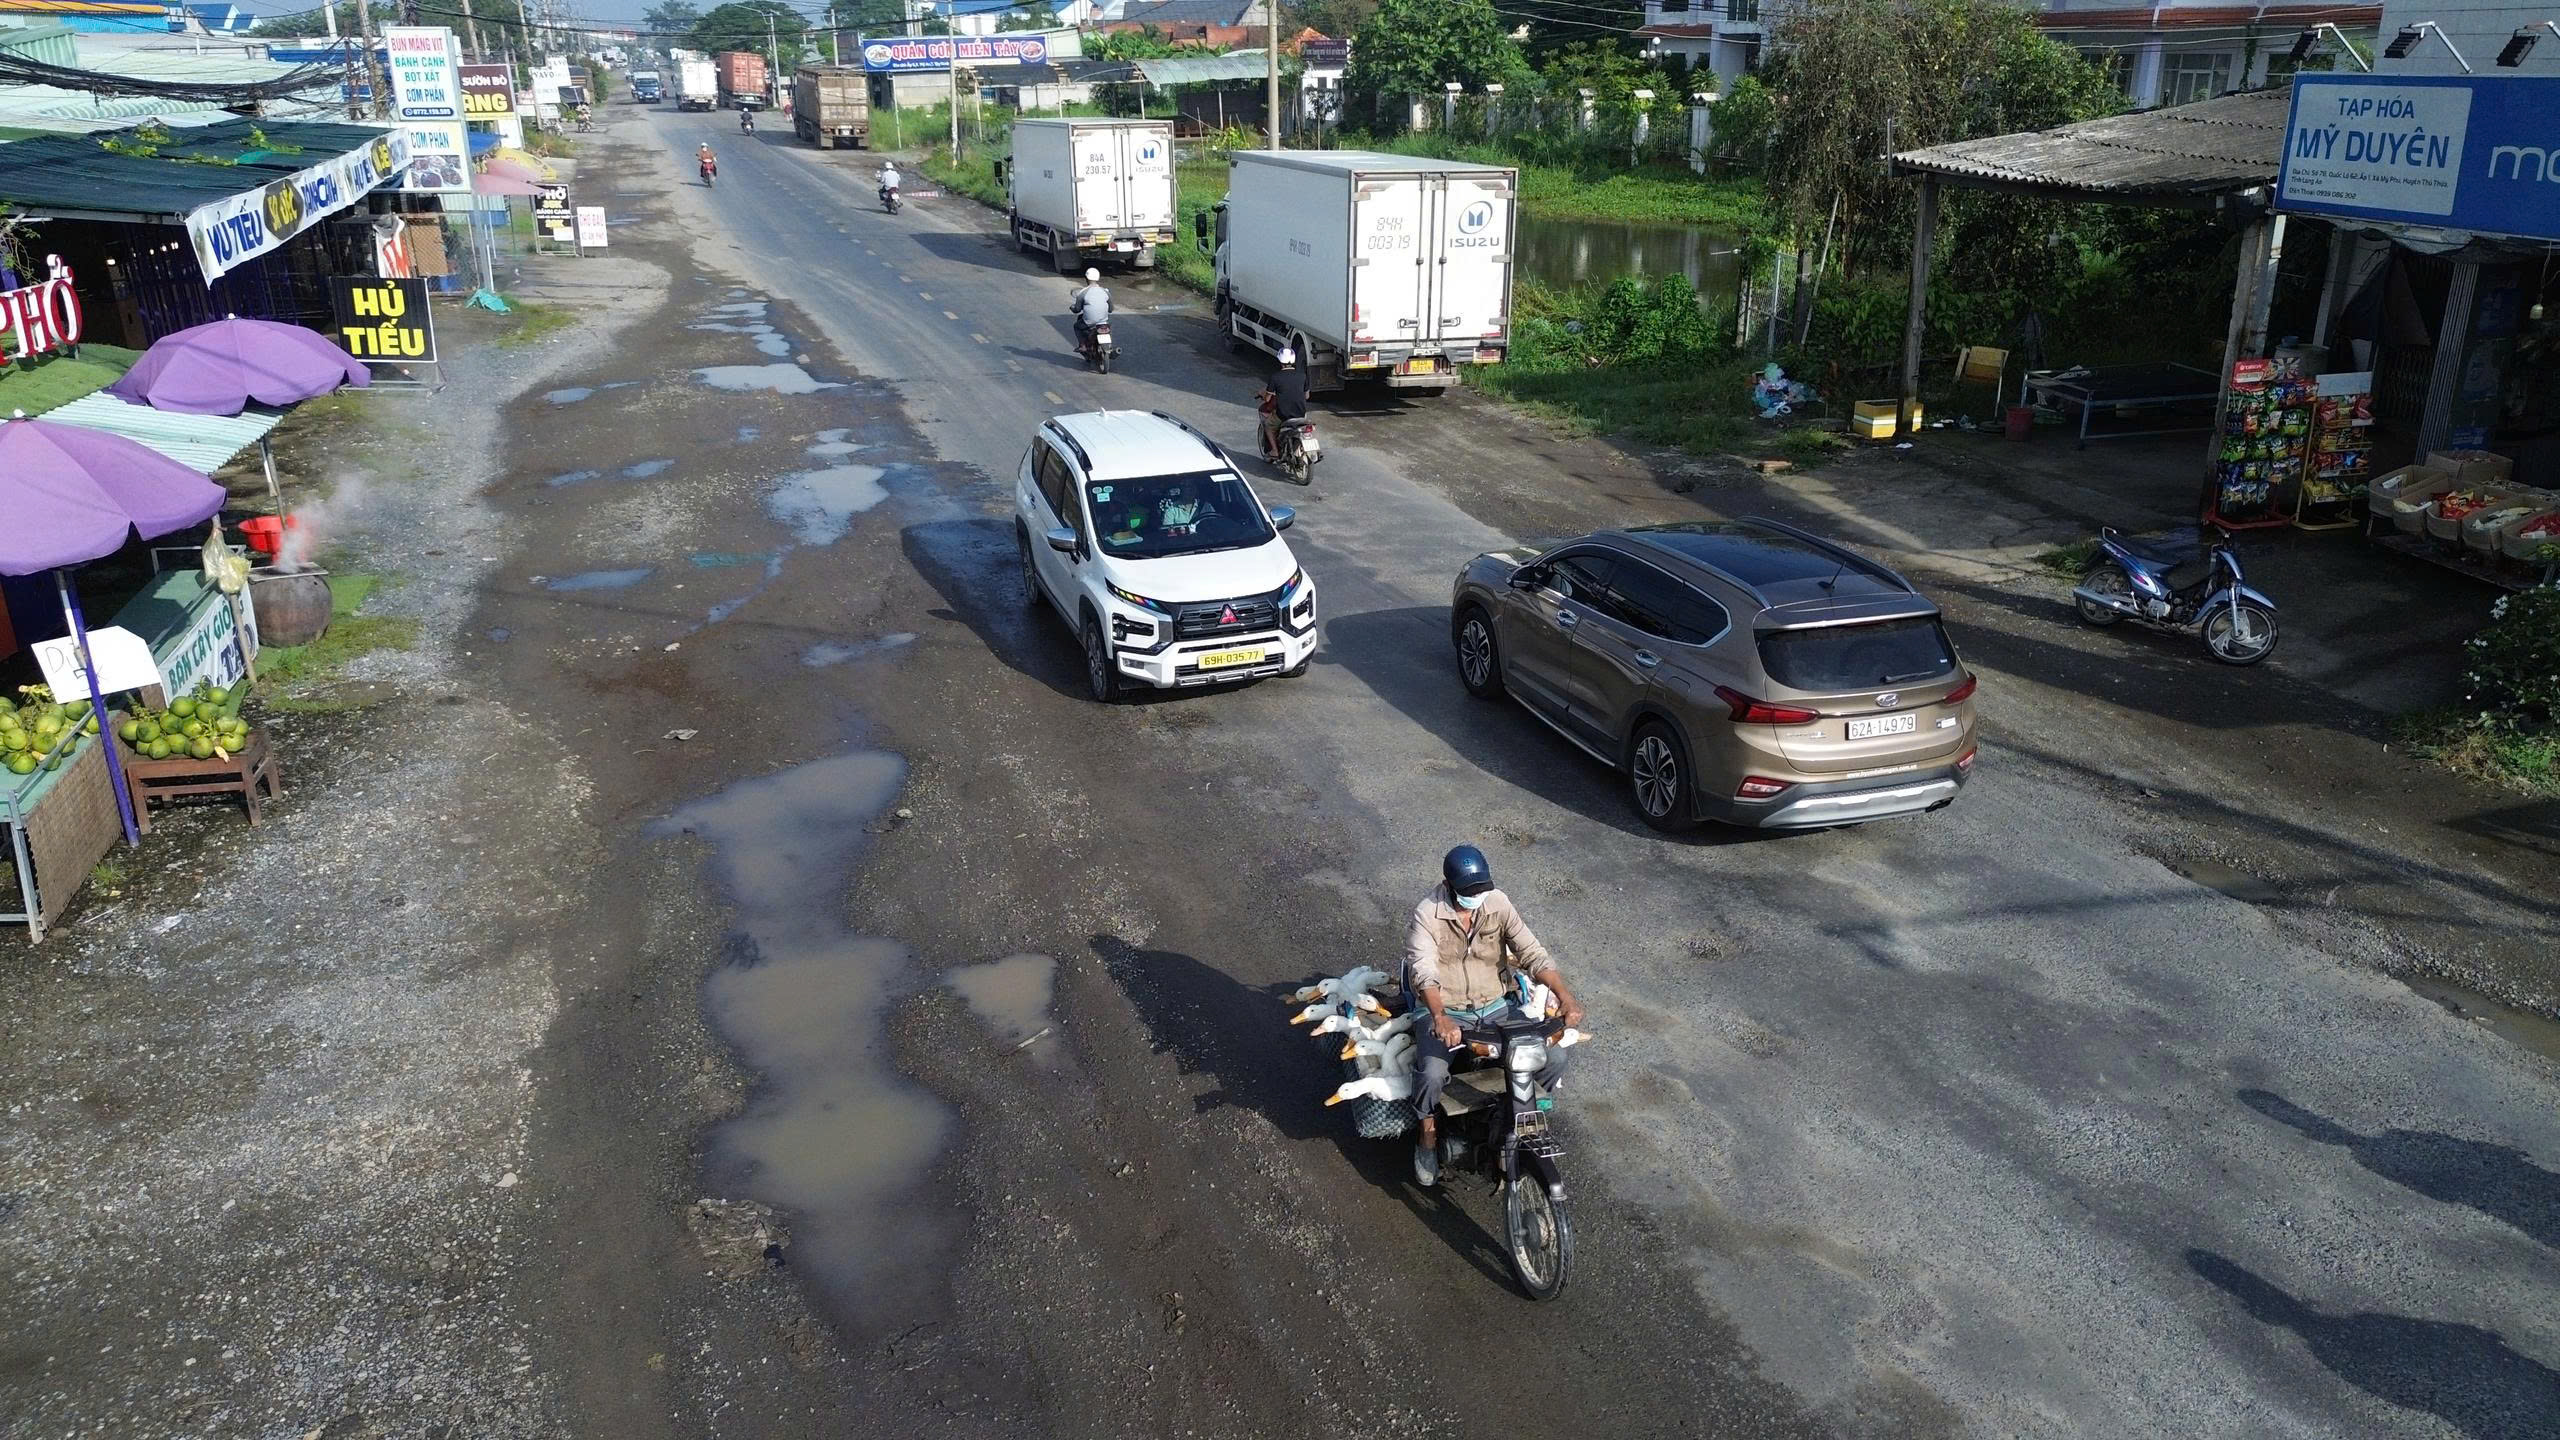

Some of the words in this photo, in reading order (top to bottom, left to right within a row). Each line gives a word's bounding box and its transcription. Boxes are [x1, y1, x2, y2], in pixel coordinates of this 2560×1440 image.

[891, 41, 927, 61] QUÁN
[993, 40, 1020, 57] TÂY
[421, 56, 446, 68] CANH
[462, 74, 491, 86] SƯỜN
[491, 74, 508, 86] BÒ
[405, 87, 423, 103] CƠM
[2338, 97, 2373, 121] TẠP
[2376, 94, 2415, 119] HÓA
[410, 131, 427, 149] CƠM
[2295, 122, 2340, 160] MỸ
[2344, 126, 2450, 169] DUYÊN
[1089, 153, 1105, 162] 84A
[1449, 236, 1501, 249] ISUZU
[352, 280, 406, 317] HỦ
[342, 318, 426, 356] TIẾU
[168, 653, 193, 697] BÁN
[191, 628, 214, 668] CÂY
